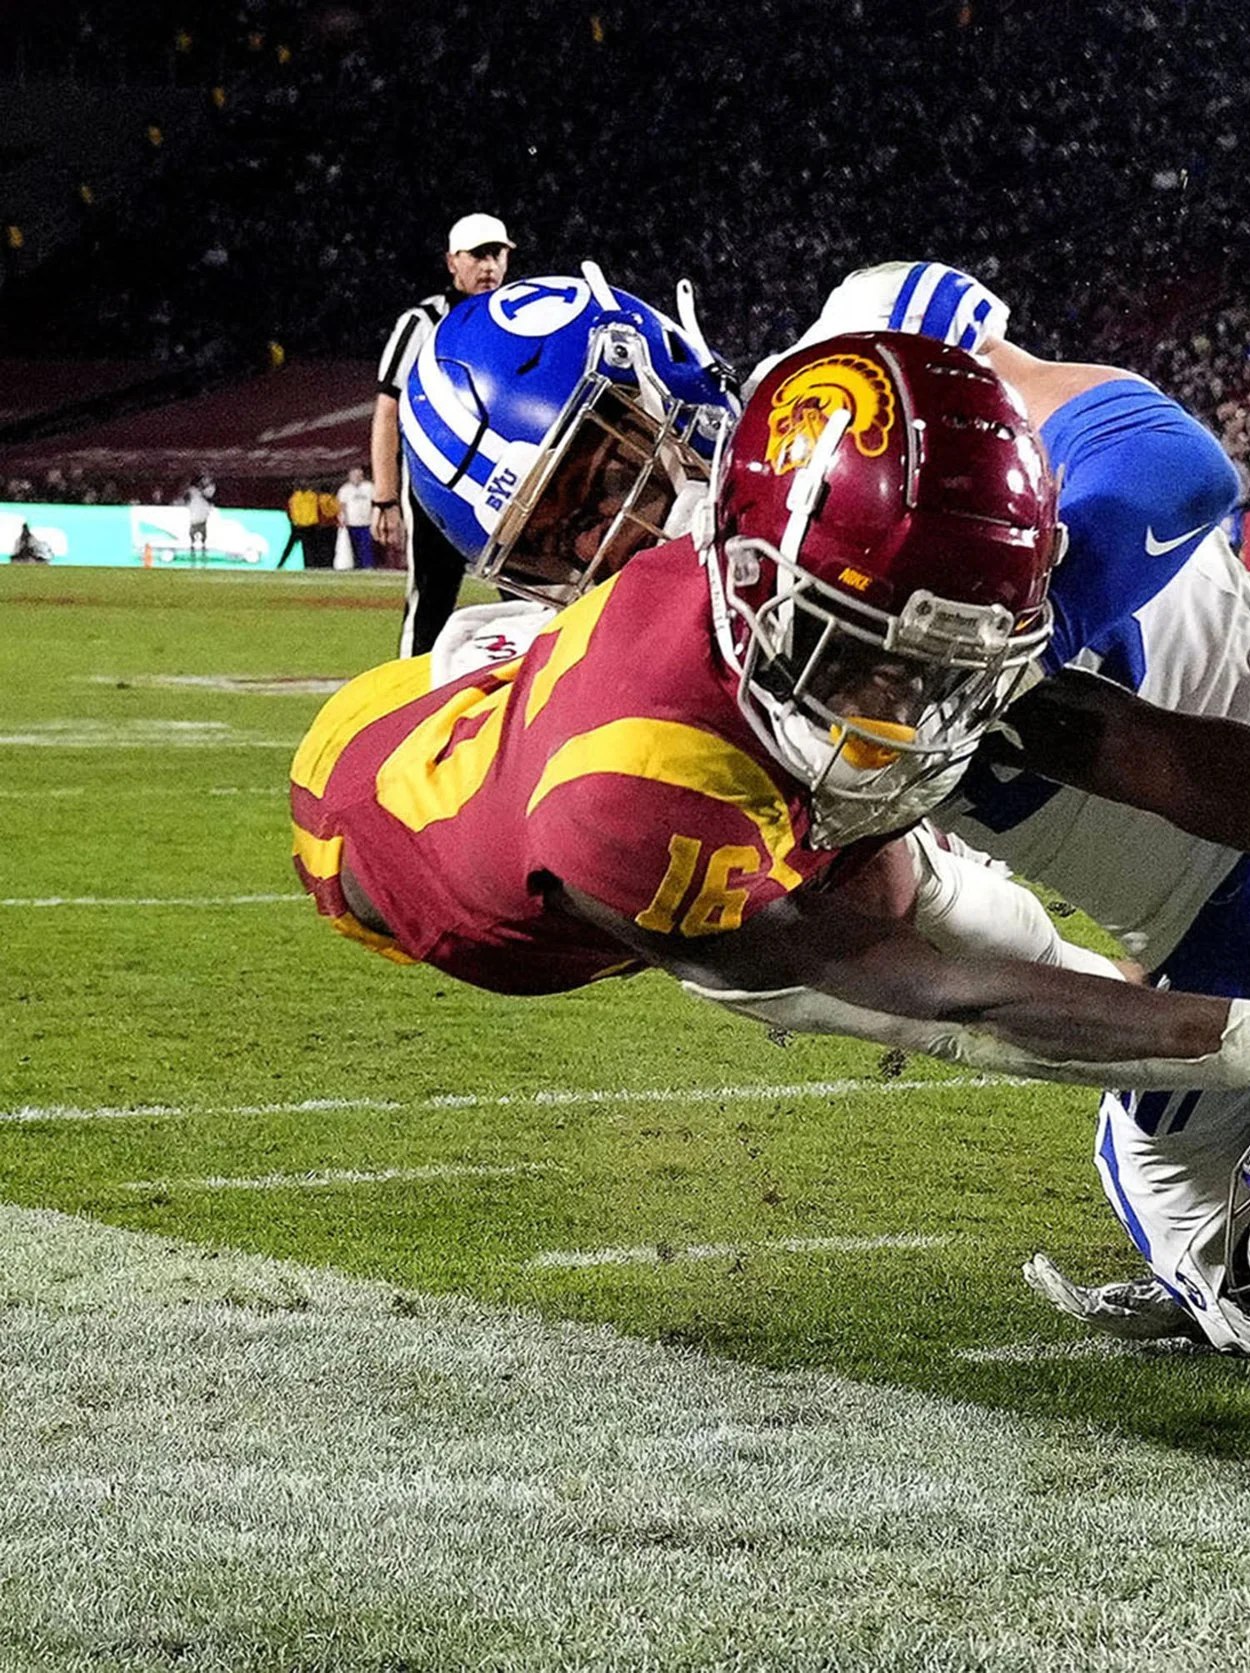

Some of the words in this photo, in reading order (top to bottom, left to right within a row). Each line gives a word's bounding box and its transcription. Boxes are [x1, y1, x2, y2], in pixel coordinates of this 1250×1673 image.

[500, 281, 578, 320] Y
[485, 468, 518, 511] BYU
[837, 567, 873, 592] NIKE
[634, 833, 761, 938] 16
